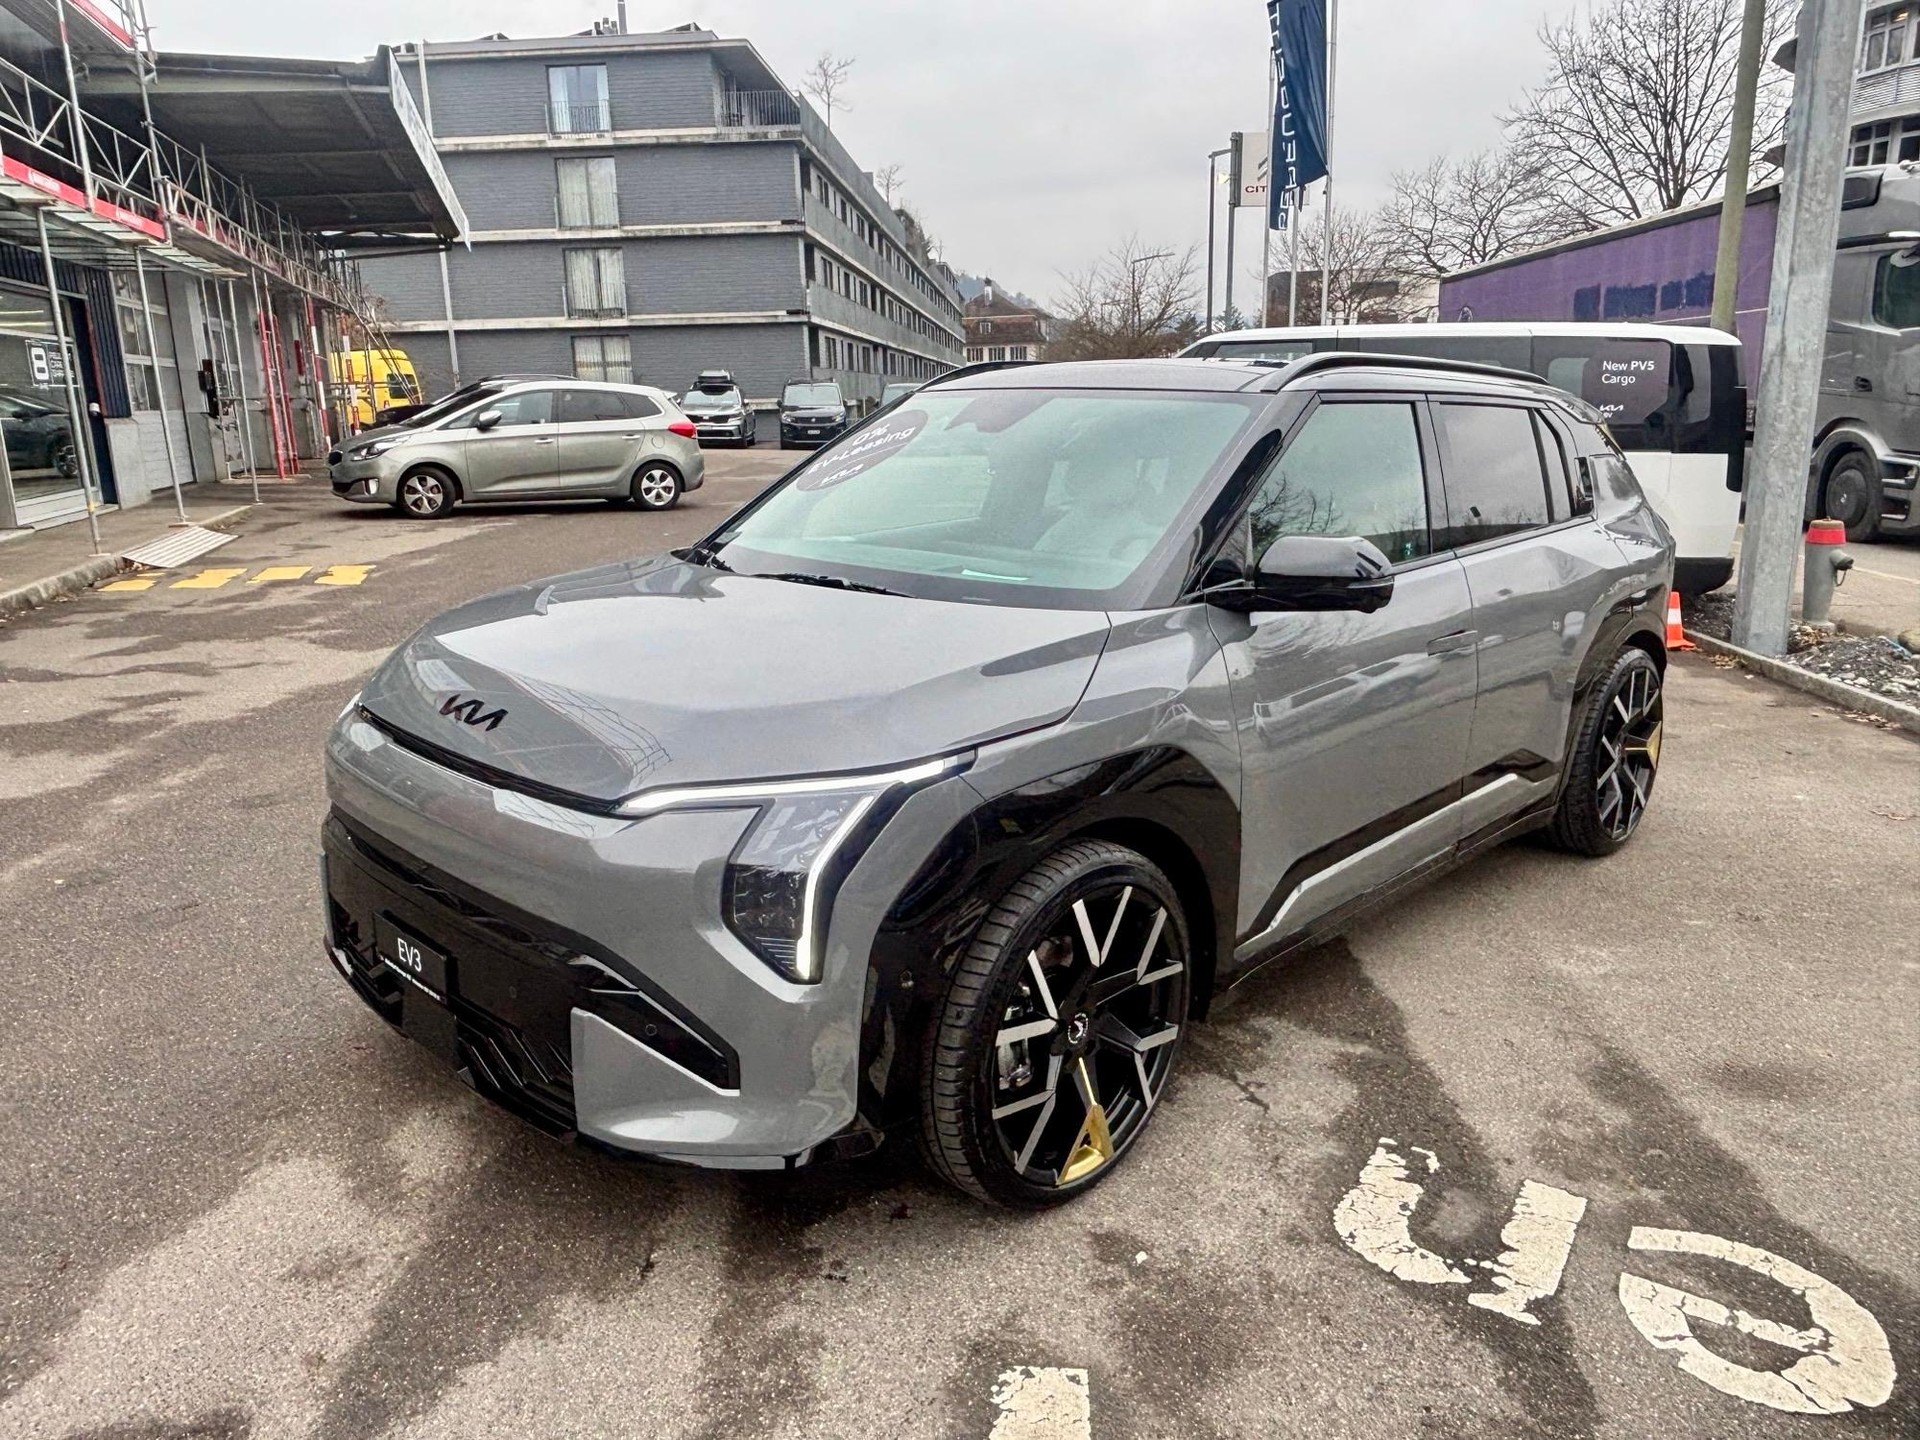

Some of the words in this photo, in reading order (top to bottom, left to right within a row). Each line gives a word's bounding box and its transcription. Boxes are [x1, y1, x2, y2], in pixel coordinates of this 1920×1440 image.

[1602, 360, 1628, 371] New
[1630, 360, 1655, 371] PV5
[1601, 373, 1636, 386] Cargo
[852, 423, 890, 447] 0%
[439, 693, 509, 732] KIA
[397, 937, 422, 972] EV3
